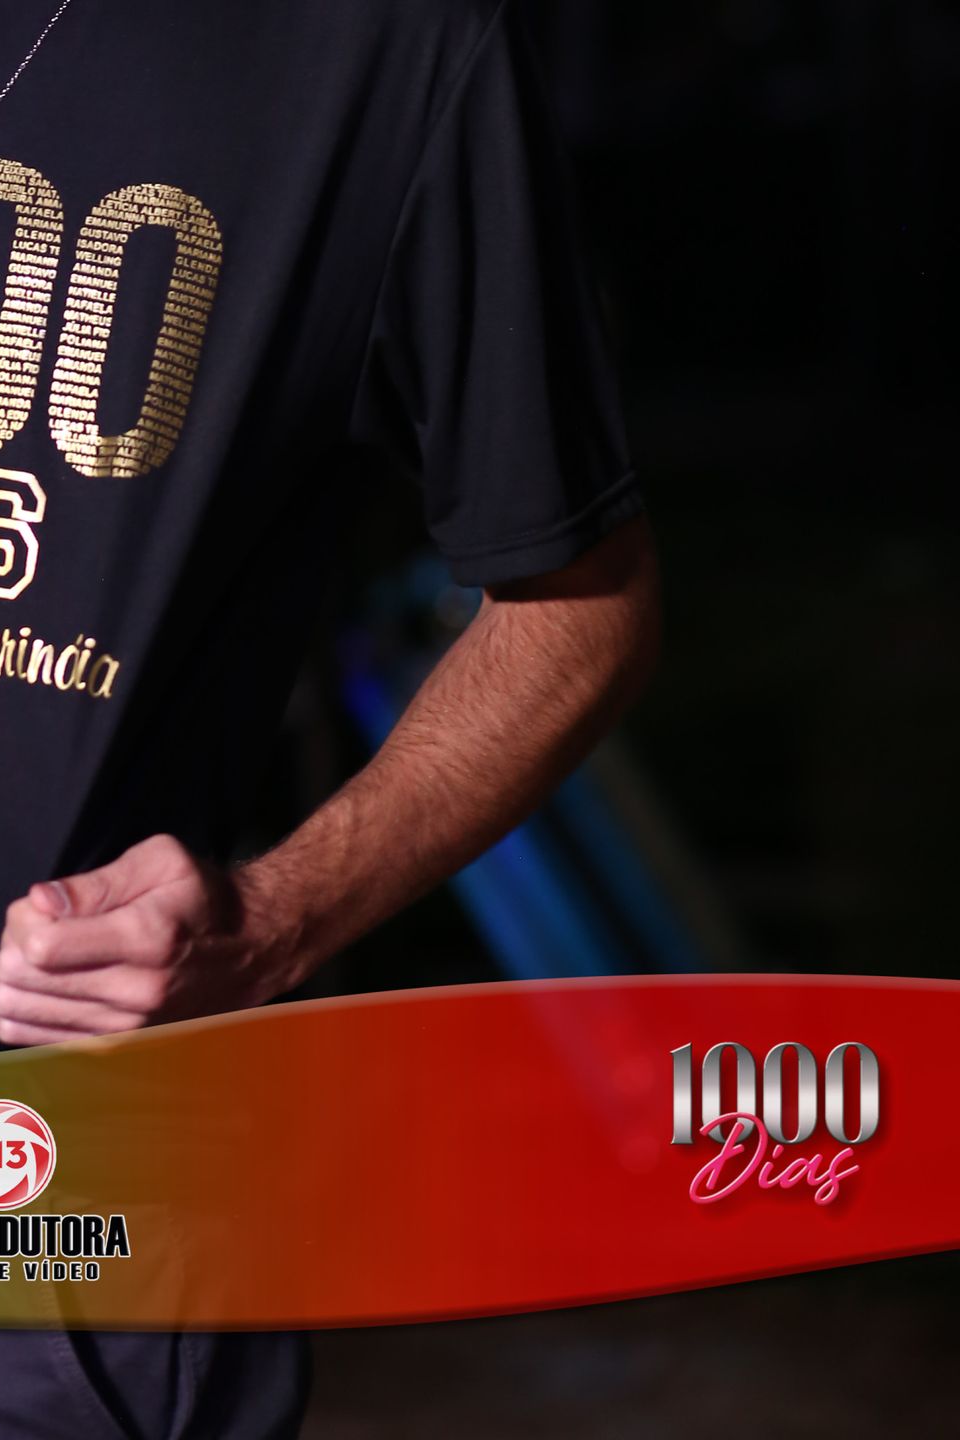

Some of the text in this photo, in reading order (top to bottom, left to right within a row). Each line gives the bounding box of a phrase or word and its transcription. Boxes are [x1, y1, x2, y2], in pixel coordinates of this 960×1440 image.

[28, 178, 54, 188] SAN
[37, 188, 60, 199] NAT
[15, 204, 64, 220] RAFAELA
[140, 206, 181, 220] ALBERT
[17, 216, 64, 232] MARIANA
[147, 216, 188, 232] SANTOS
[15, 227, 61, 243] GLENDA
[80, 227, 128, 243] GUSTAVO
[12, 240, 48, 253] LUCAS
[77, 239, 123, 255] ISADORA
[75, 250, 122, 267] WELLING
[8, 263, 57, 279] GUSTAVO
[73, 262, 119, 278] AMANDA
